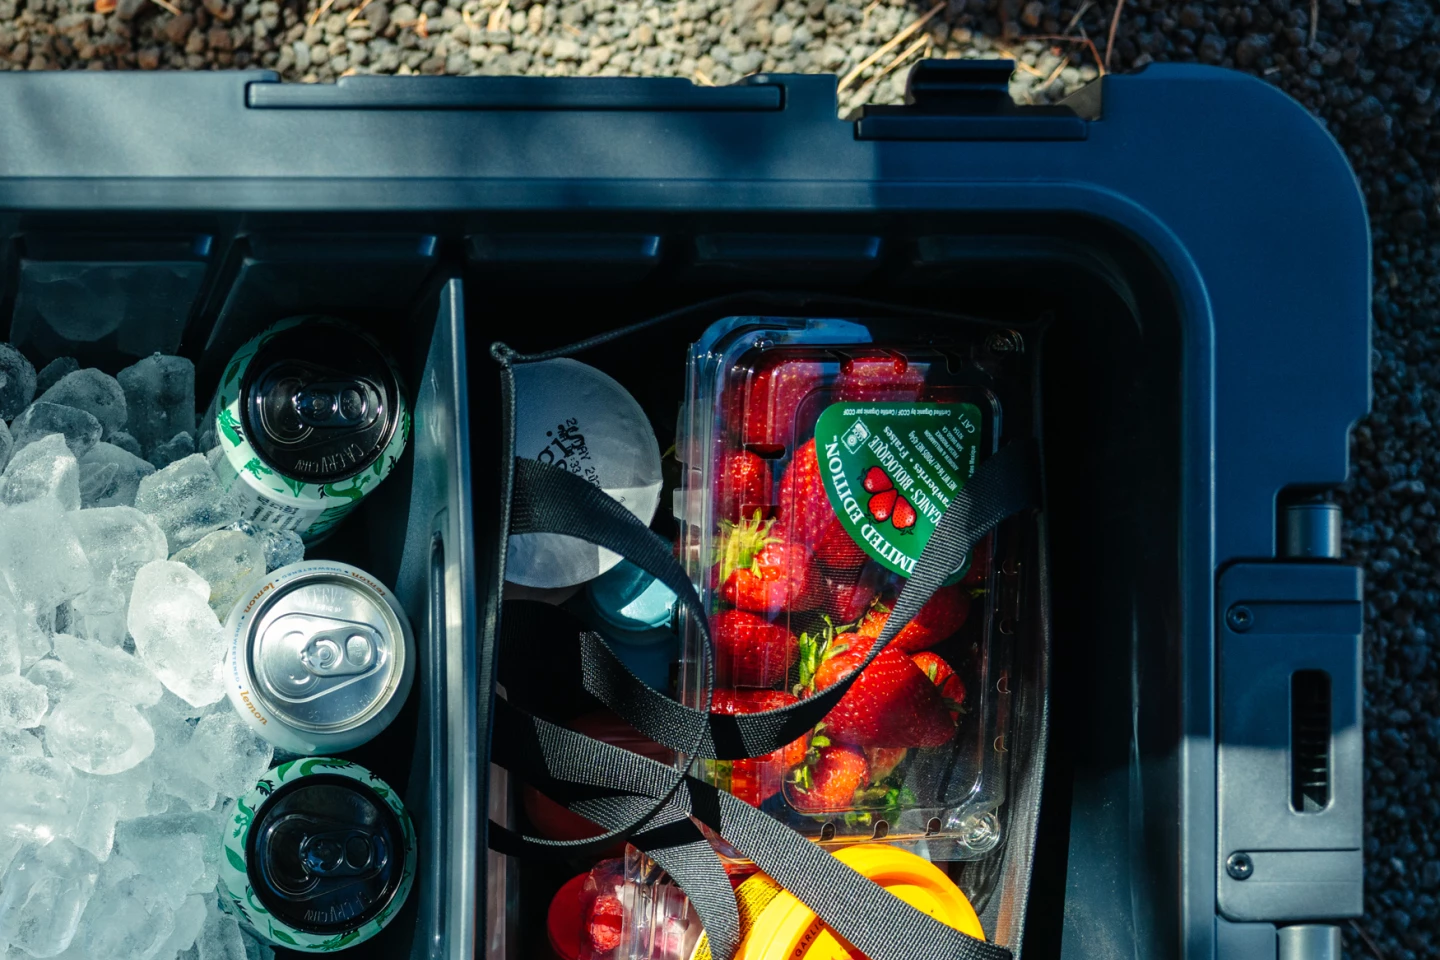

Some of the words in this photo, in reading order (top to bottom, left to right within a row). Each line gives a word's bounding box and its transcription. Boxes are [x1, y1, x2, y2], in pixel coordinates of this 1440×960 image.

[882, 426, 908, 457] Fraises
[961, 418, 975, 433] CAT
[867, 435, 915, 488] BIOLOGIQUE
[825, 440, 864, 525] EDITION
[911, 464, 949, 508] rawberries
[911, 489, 942, 524] GANICS
[860, 523, 919, 574] IMITED
[243, 582, 275, 613] lemon
[351, 570, 386, 597] lemon
[239, 690, 268, 726] lemon
[795, 918, 825, 957] GARLIC
